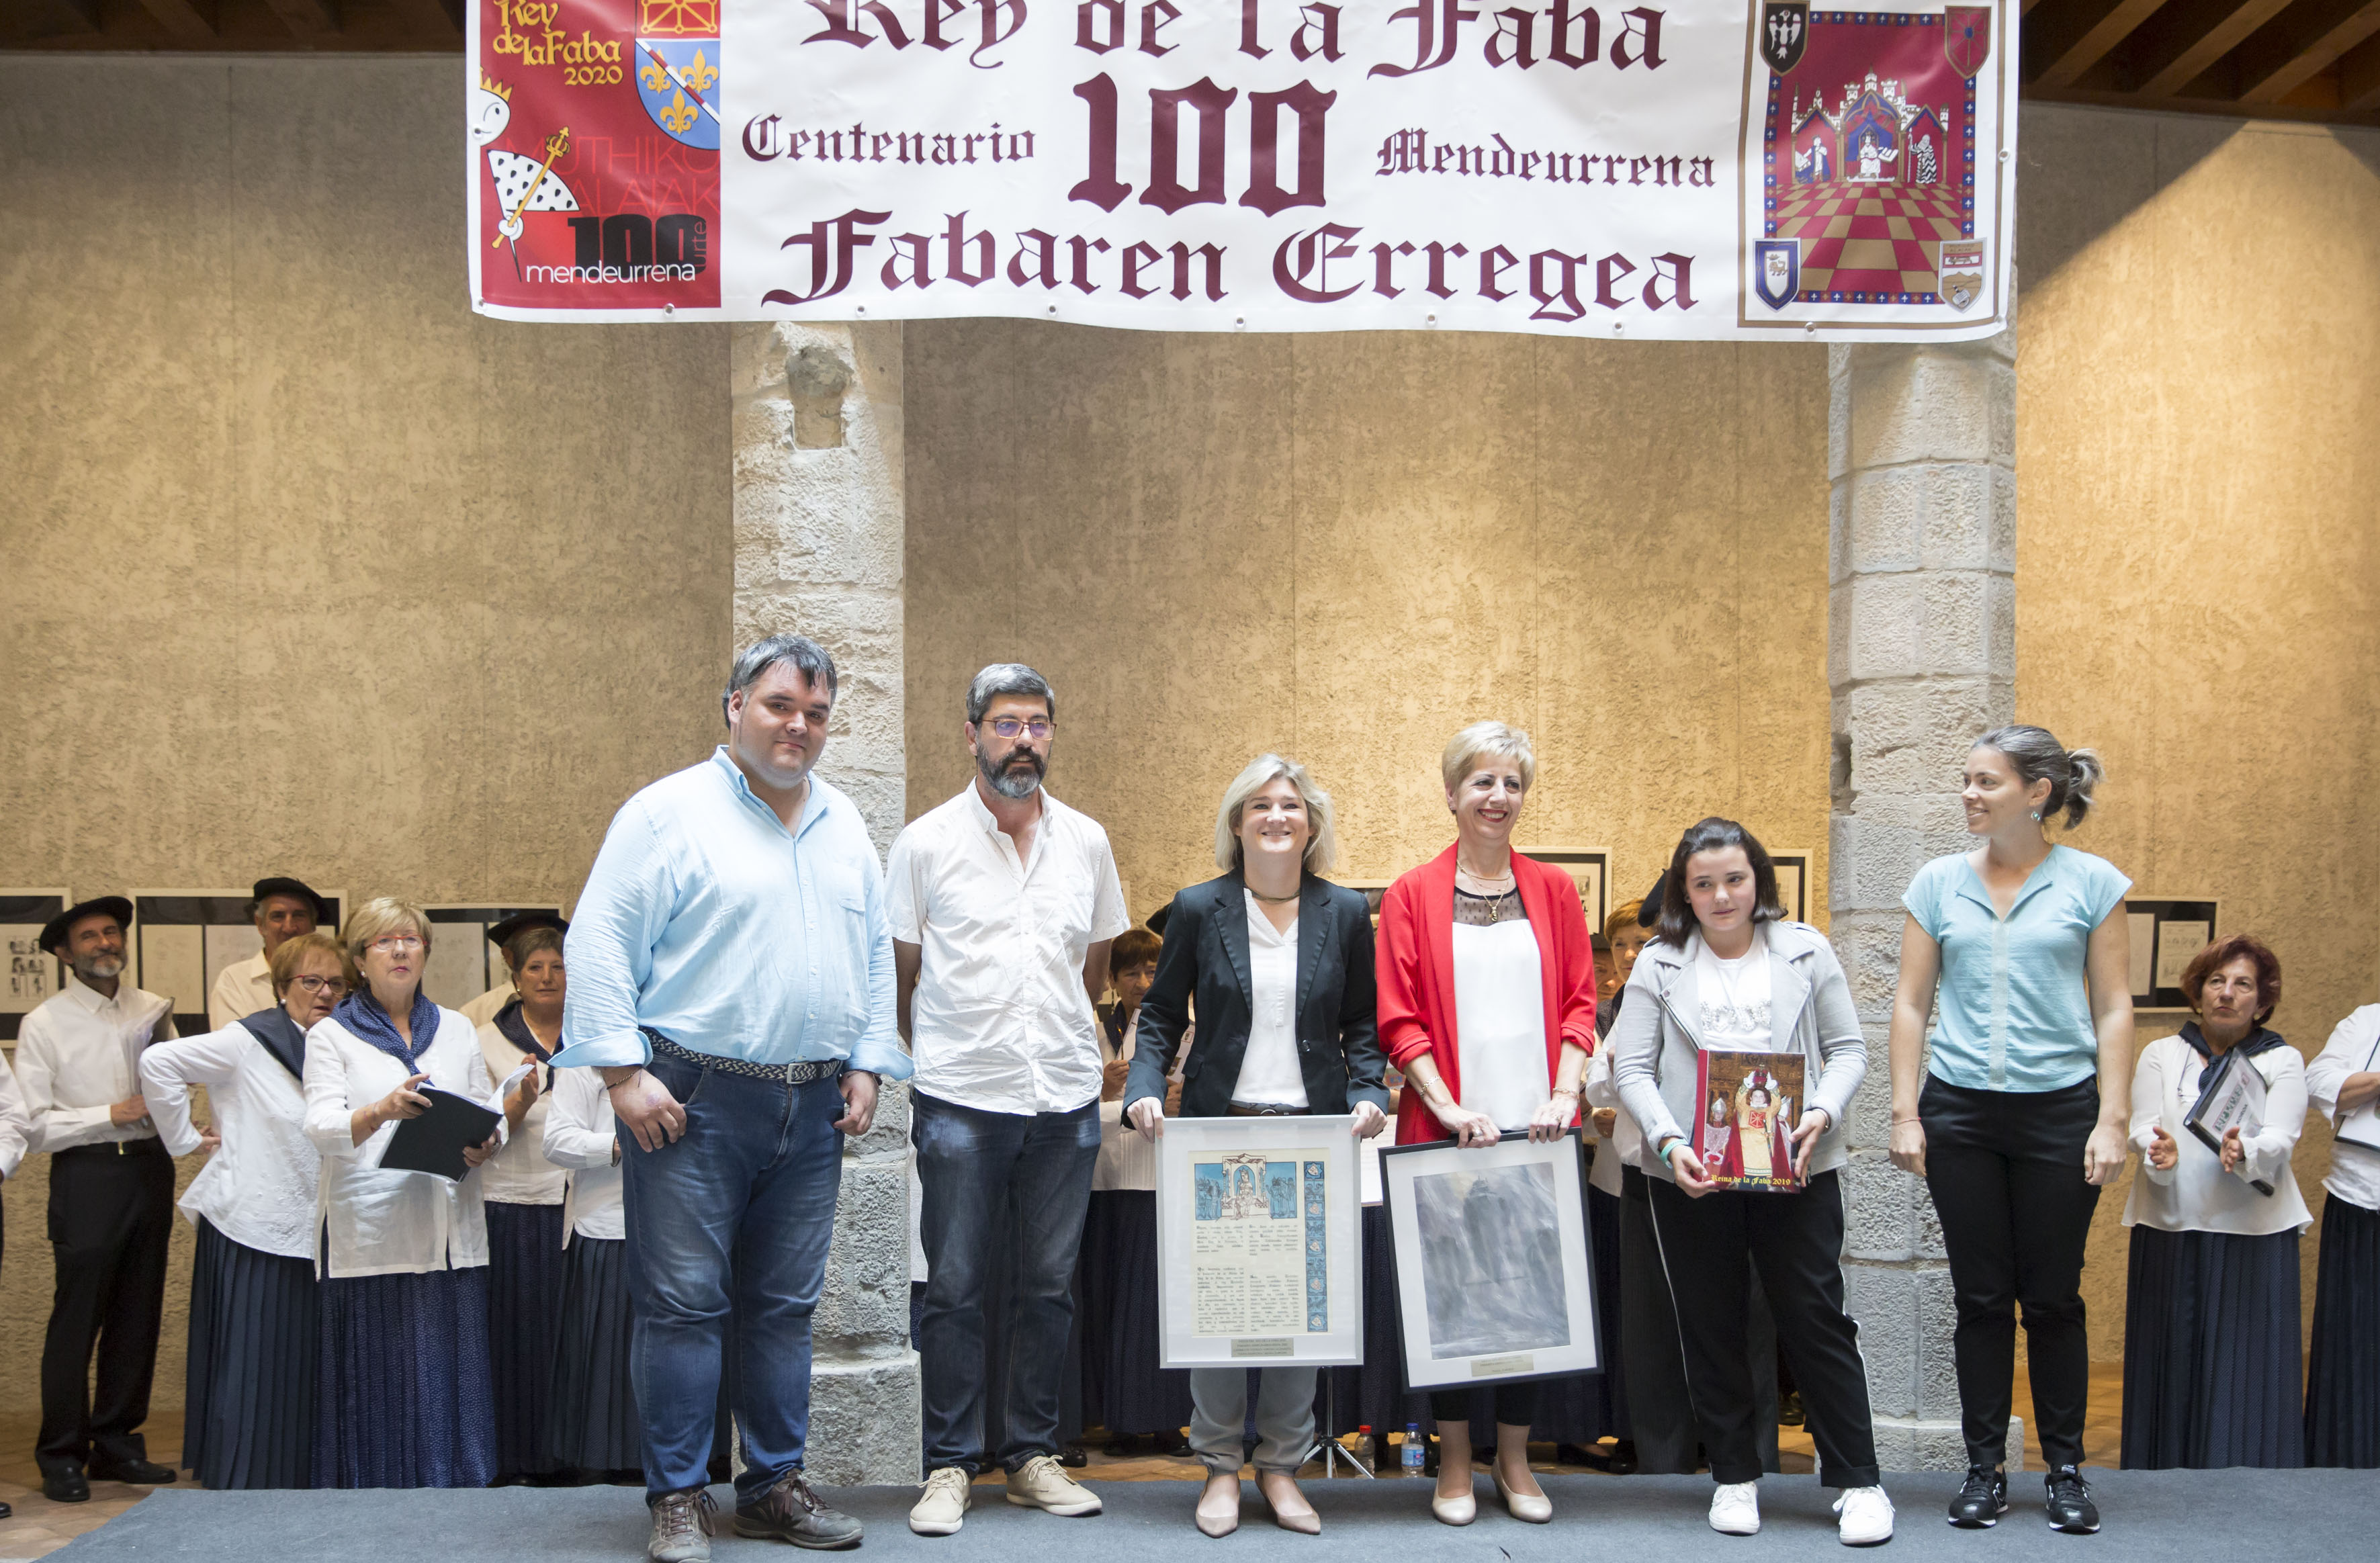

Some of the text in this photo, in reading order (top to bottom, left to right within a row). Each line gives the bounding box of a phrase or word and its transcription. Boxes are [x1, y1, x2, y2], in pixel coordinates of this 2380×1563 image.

[493, 0, 560, 34] Rey
[492, 26, 623, 66] de la Faba
[800, 0, 1667, 81] Rey de la Faba
[564, 65, 623, 86] 2020
[742, 71, 1716, 218] Centenario 100 Mendeurrena
[568, 214, 707, 278] 100
[761, 208, 1700, 323] Fabaren Erregea
[526, 259, 697, 284] mendeurrena
[1711, 1174, 1732, 1183] Reina
[1751, 1177, 1771, 1186] Faba
[1772, 1177, 1791, 1186] 2019
